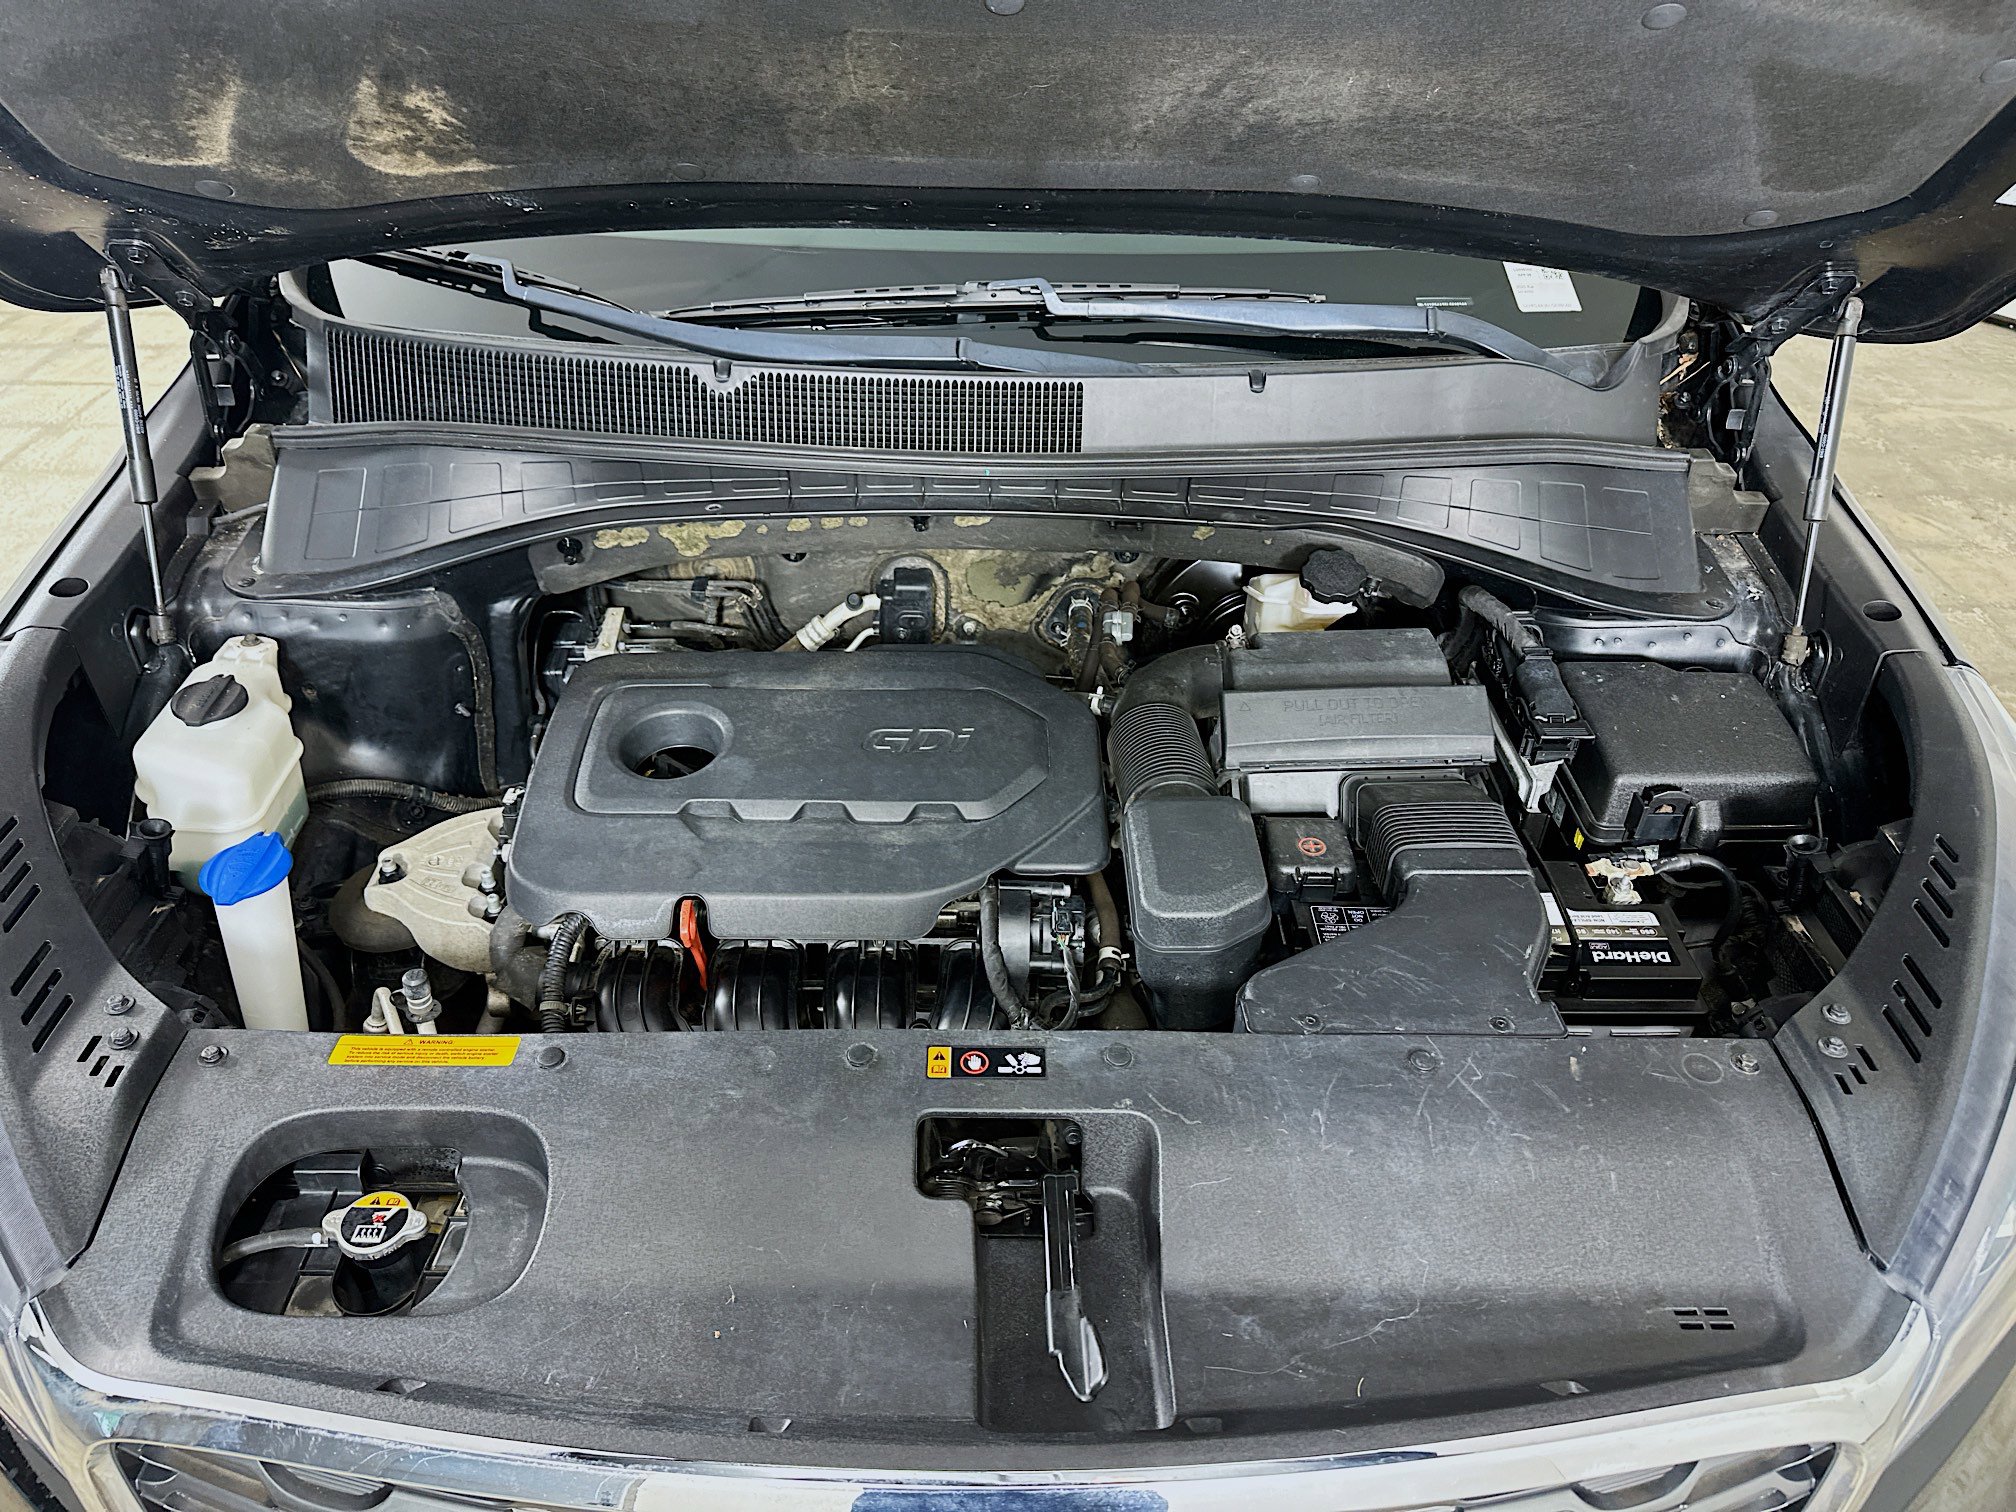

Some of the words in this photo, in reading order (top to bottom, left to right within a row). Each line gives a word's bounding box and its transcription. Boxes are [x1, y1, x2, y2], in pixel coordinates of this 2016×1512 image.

[1284, 699, 1323, 712] PULL
[1328, 698, 1358, 711] OUT
[862, 727, 975, 753] GDi
[1592, 951, 1671, 963] DieHard
